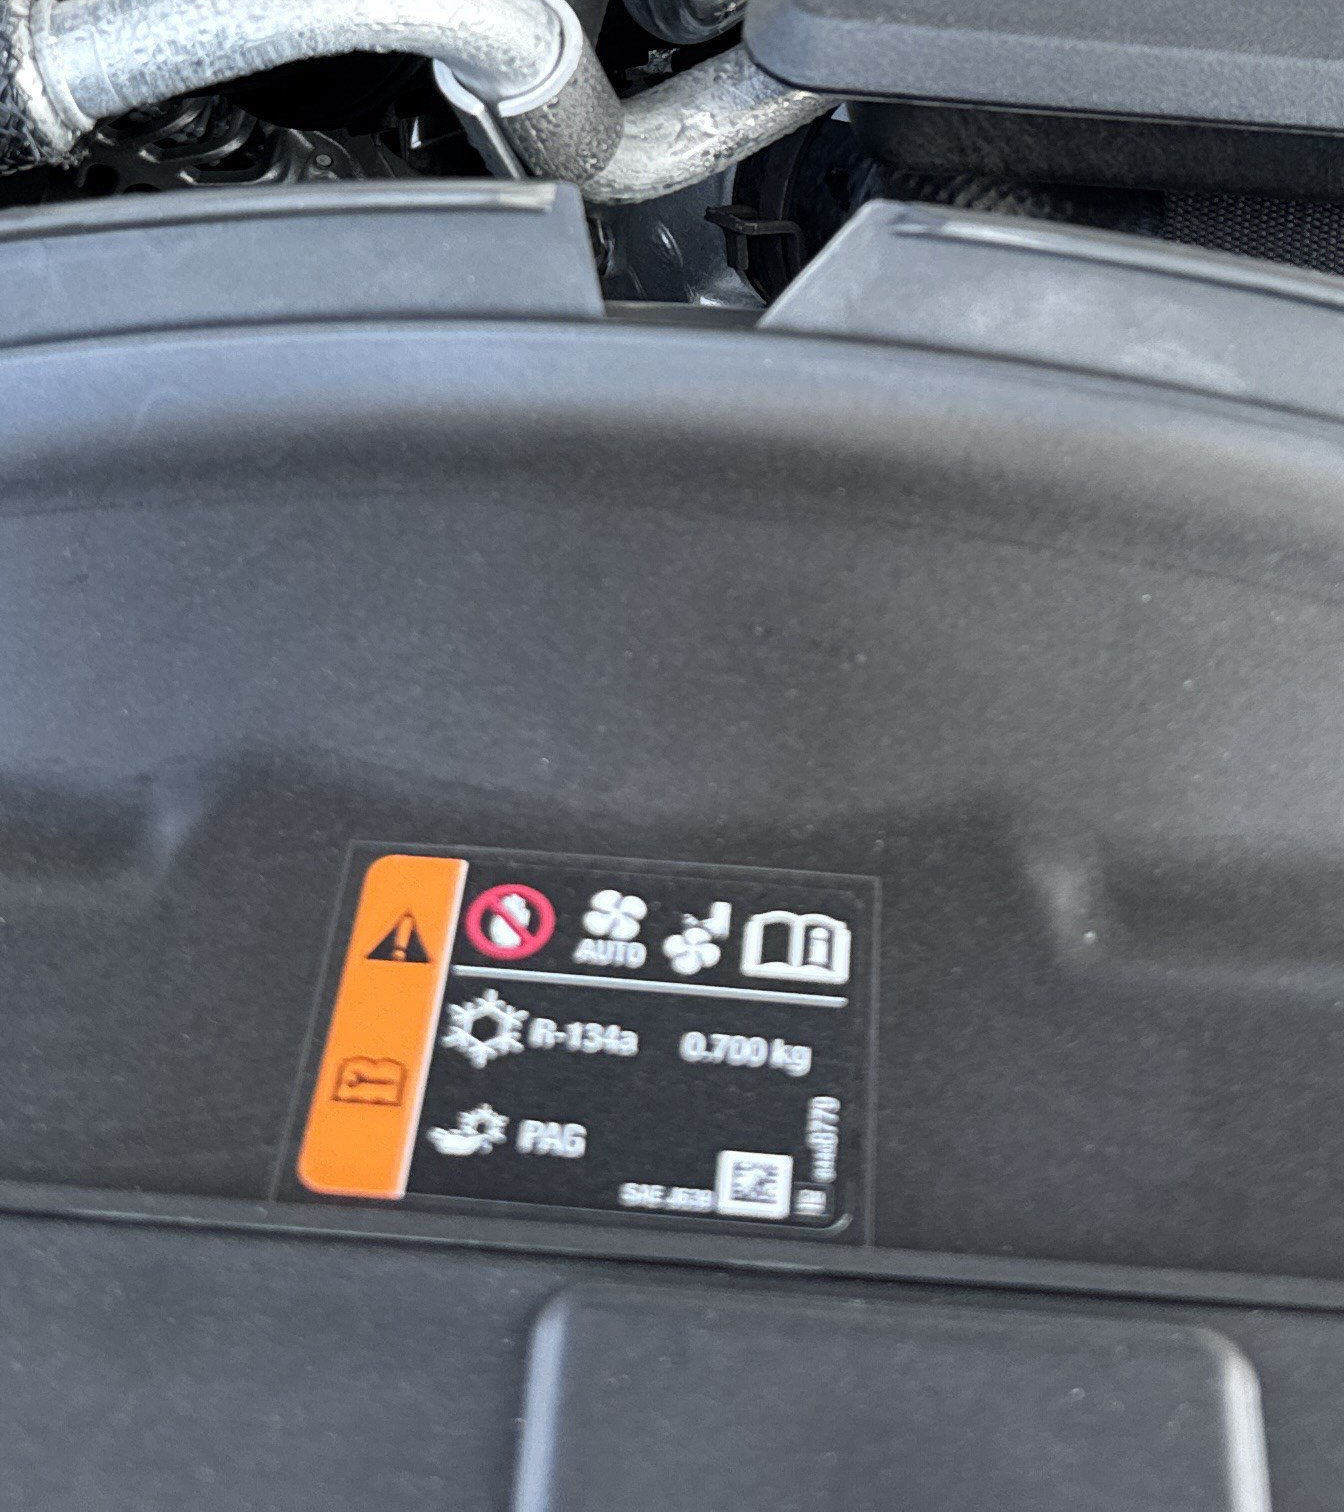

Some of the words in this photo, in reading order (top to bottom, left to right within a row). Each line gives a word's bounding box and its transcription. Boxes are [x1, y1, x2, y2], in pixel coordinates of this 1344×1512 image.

[573, 939, 647, 969] AUTO
[528, 1018, 639, 1057] R-134a
[679, 1031, 768, 1068] 0.700
[768, 1038, 812, 1077] kg
[516, 1119, 588, 1158] PAG
